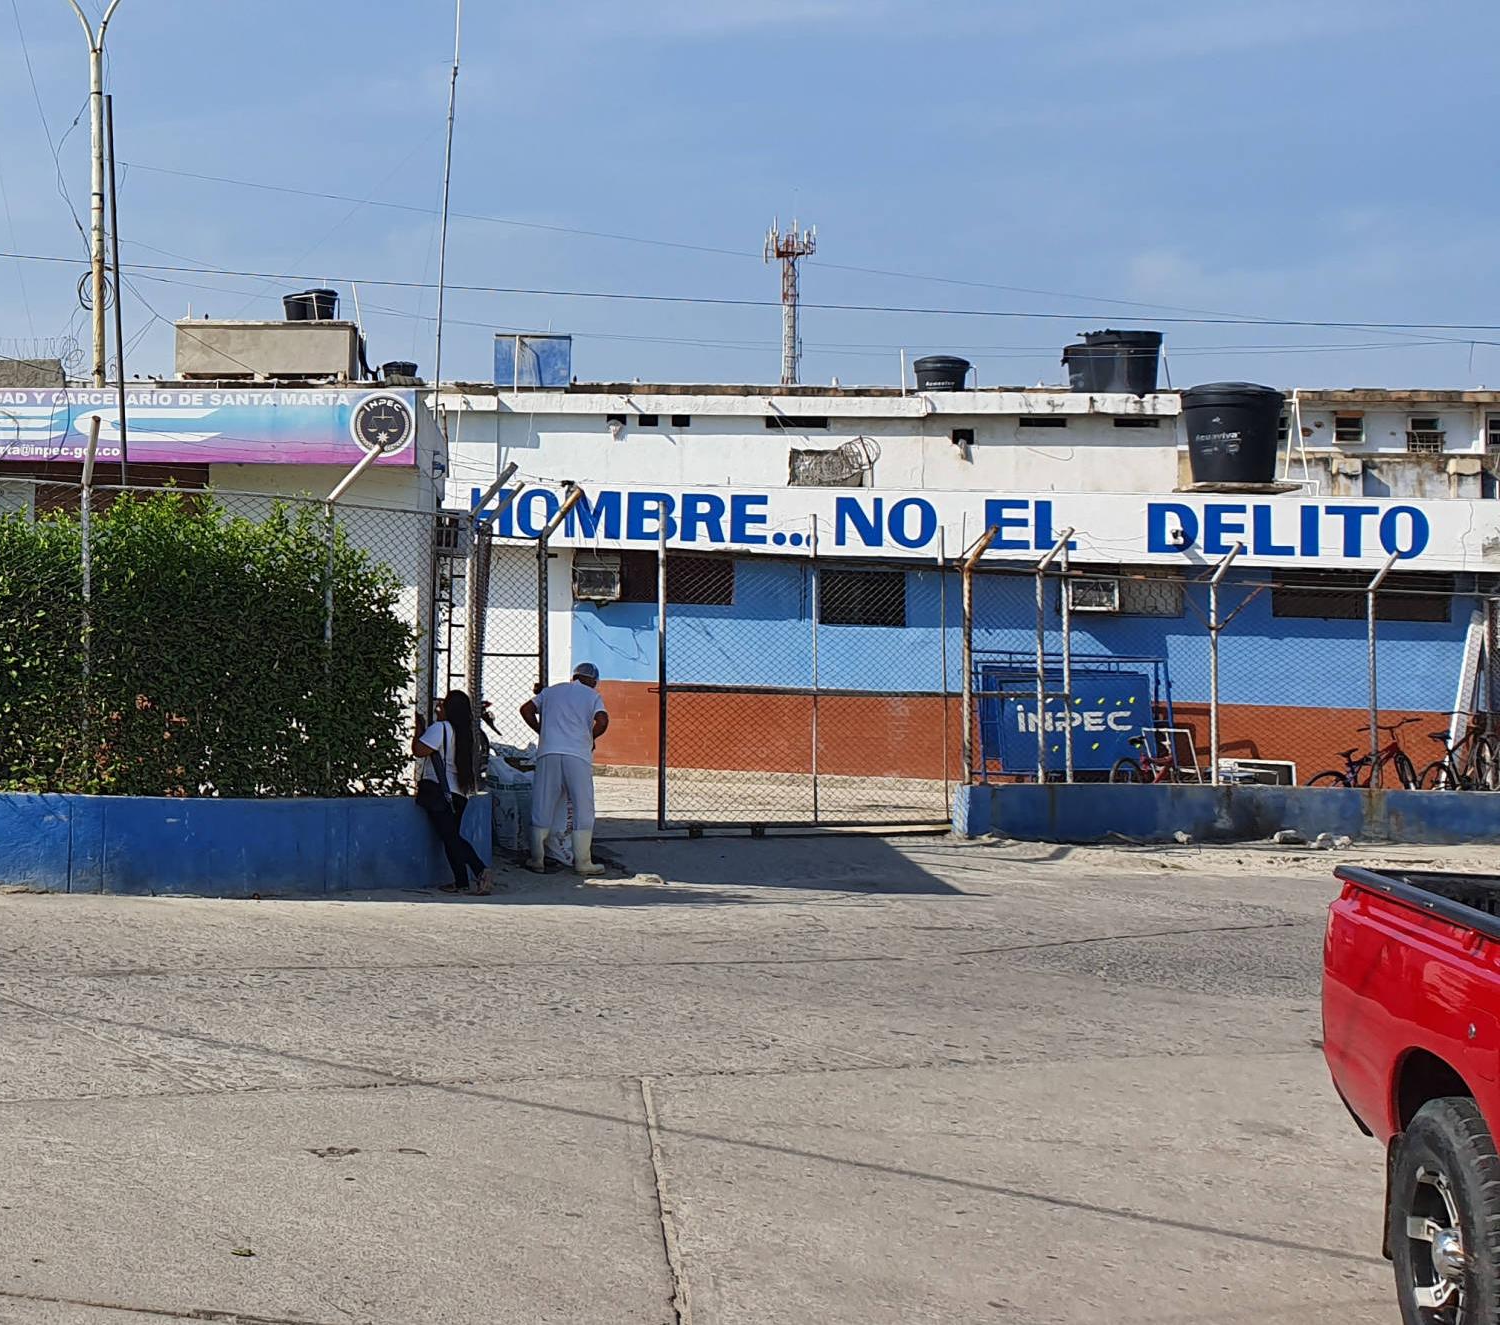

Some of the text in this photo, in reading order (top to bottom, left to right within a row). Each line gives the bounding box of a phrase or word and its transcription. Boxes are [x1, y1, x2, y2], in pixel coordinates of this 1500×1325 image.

[33, 392, 46, 405] Y
[179, 393, 204, 406] DE
[210, 393, 274, 406] SANTA
[281, 393, 350, 406] MARTA
[363, 399, 402, 412] INPEC
[471, 488, 1430, 560] HOMBRE... NO EL DELITO
